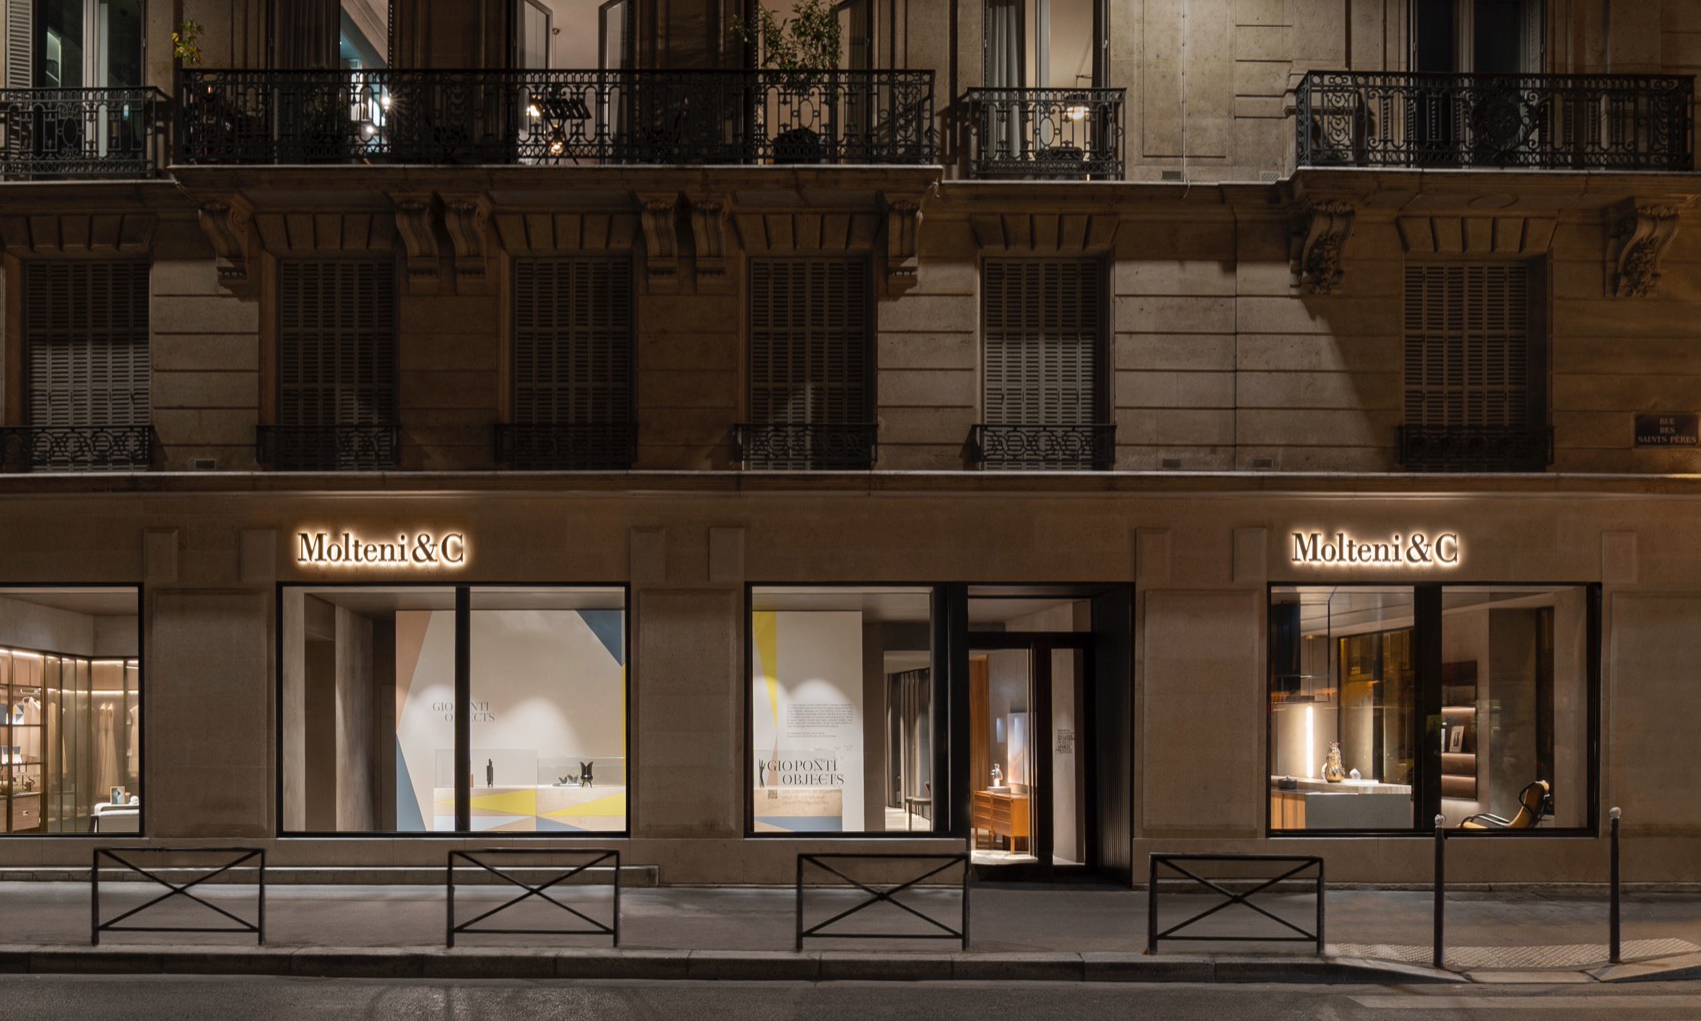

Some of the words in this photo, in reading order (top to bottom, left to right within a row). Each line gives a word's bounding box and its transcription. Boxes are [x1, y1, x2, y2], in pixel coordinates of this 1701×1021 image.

[1659, 417, 1675, 425] RUE
[1659, 426, 1676, 434] DES
[1637, 435, 1667, 443] SAINTS
[297, 532, 464, 563] Molteni&C
[1291, 532, 1458, 563] Molteni&C
[782, 773, 845, 785] OBJECTS
